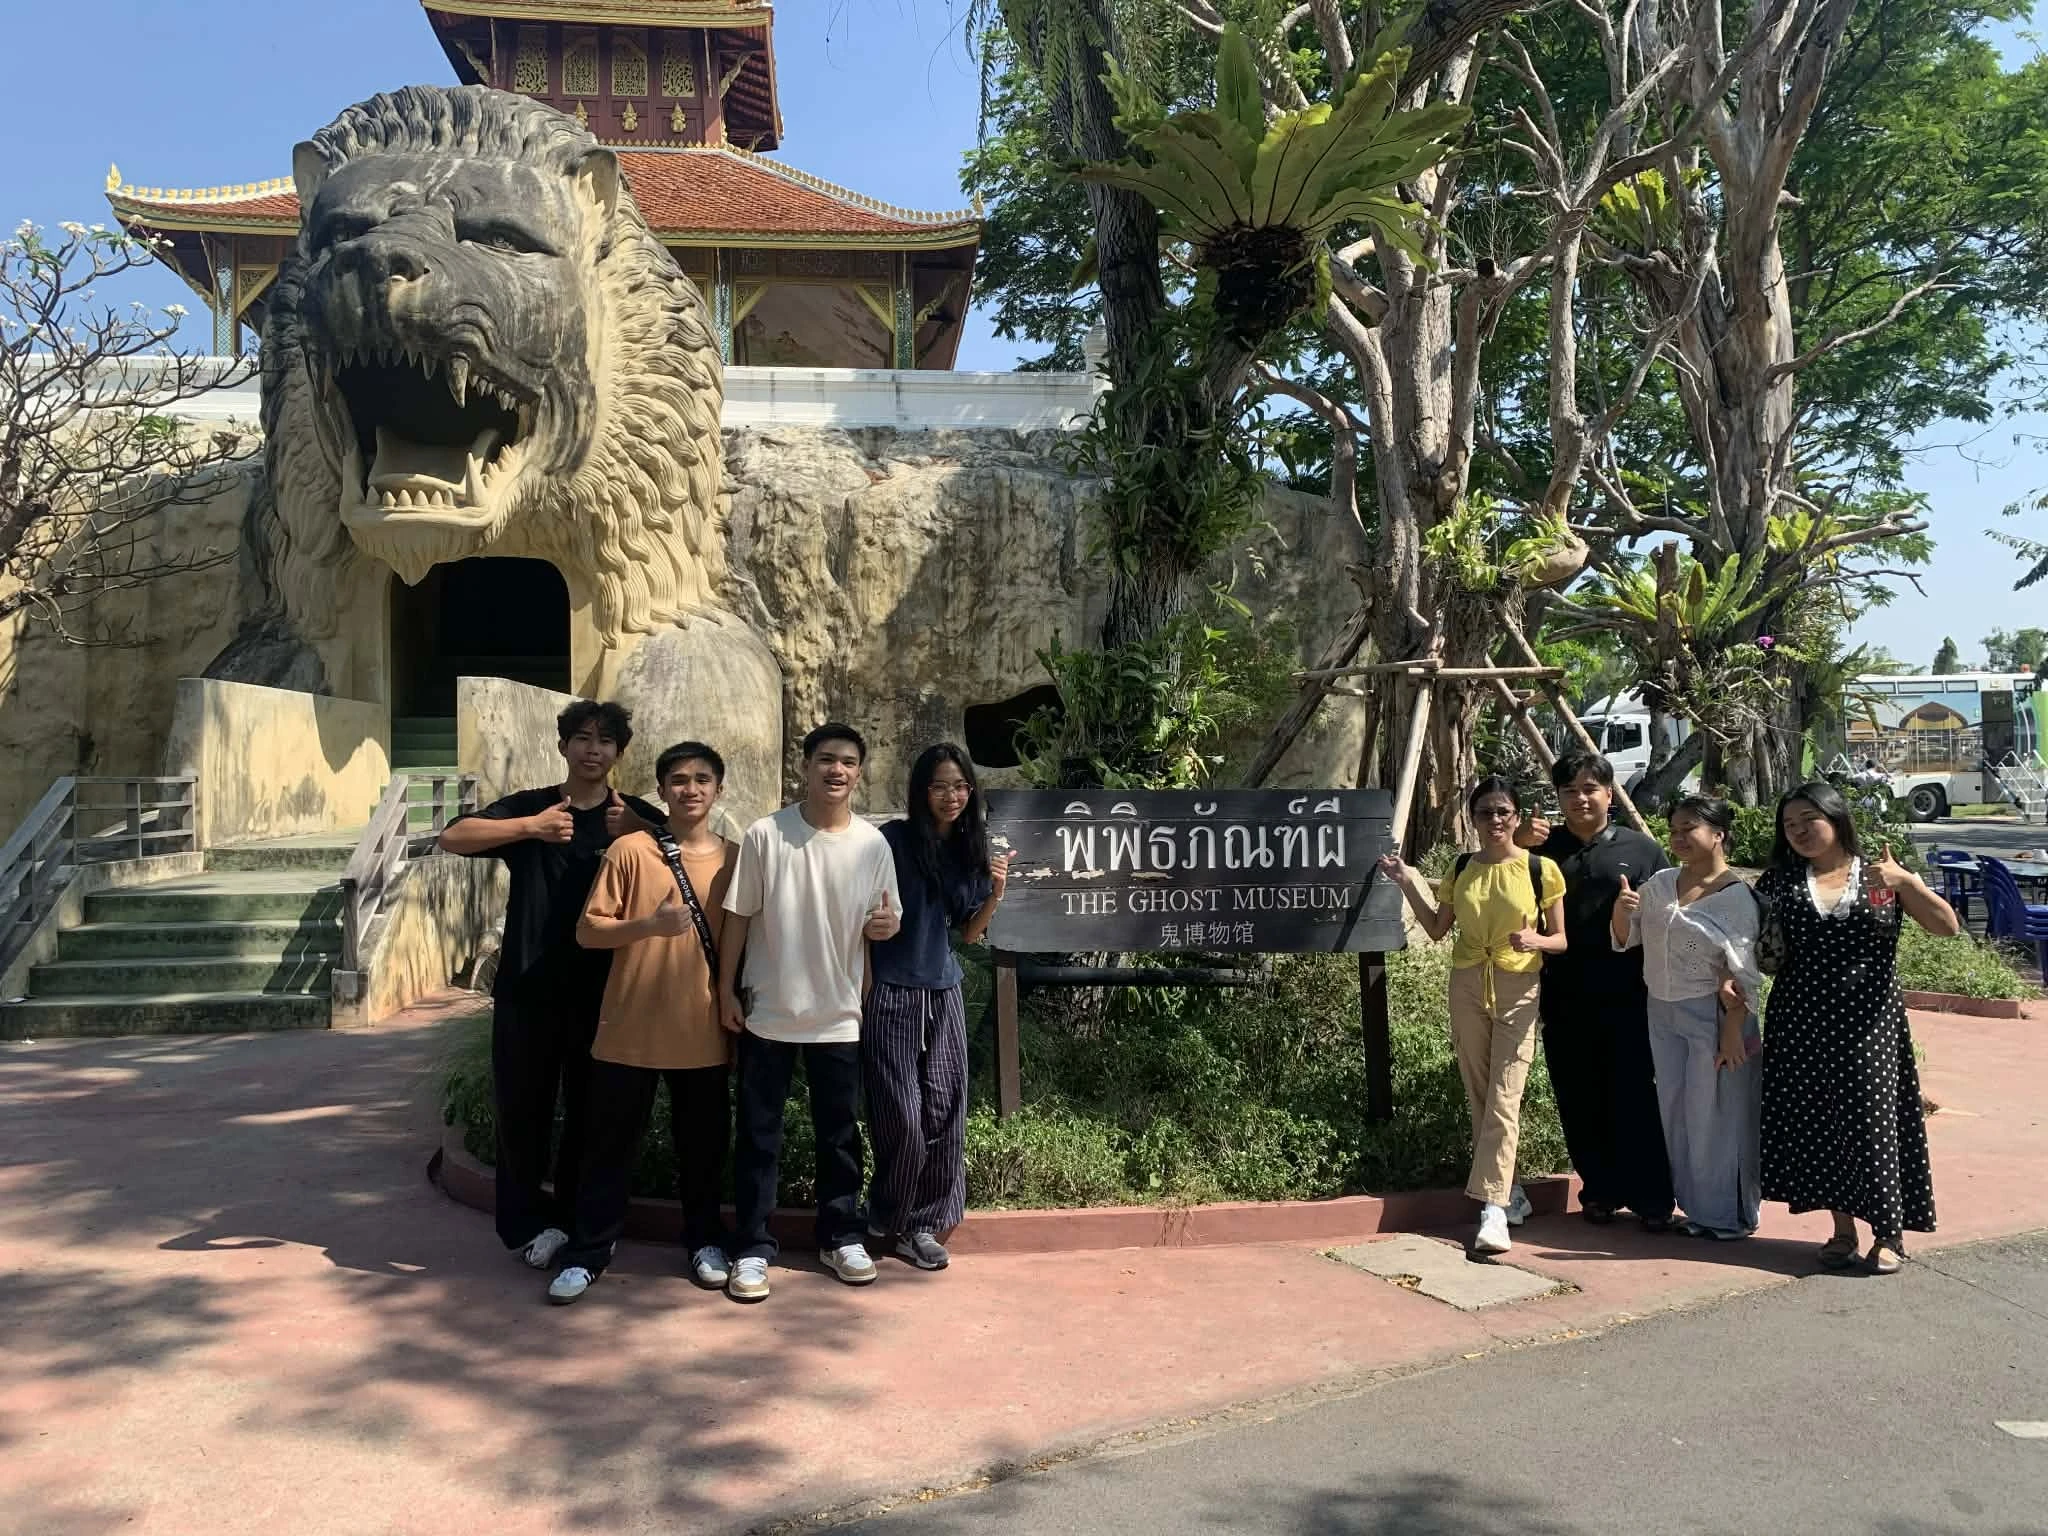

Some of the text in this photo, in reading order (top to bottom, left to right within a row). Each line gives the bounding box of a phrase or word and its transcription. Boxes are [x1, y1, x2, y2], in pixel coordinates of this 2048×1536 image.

[1056, 796, 1345, 871] พิพิธภัณฑ์ผี
[1061, 886, 1351, 915] THE GHOST MUSEUM
[1160, 921, 1255, 947] 鬼博物馆
